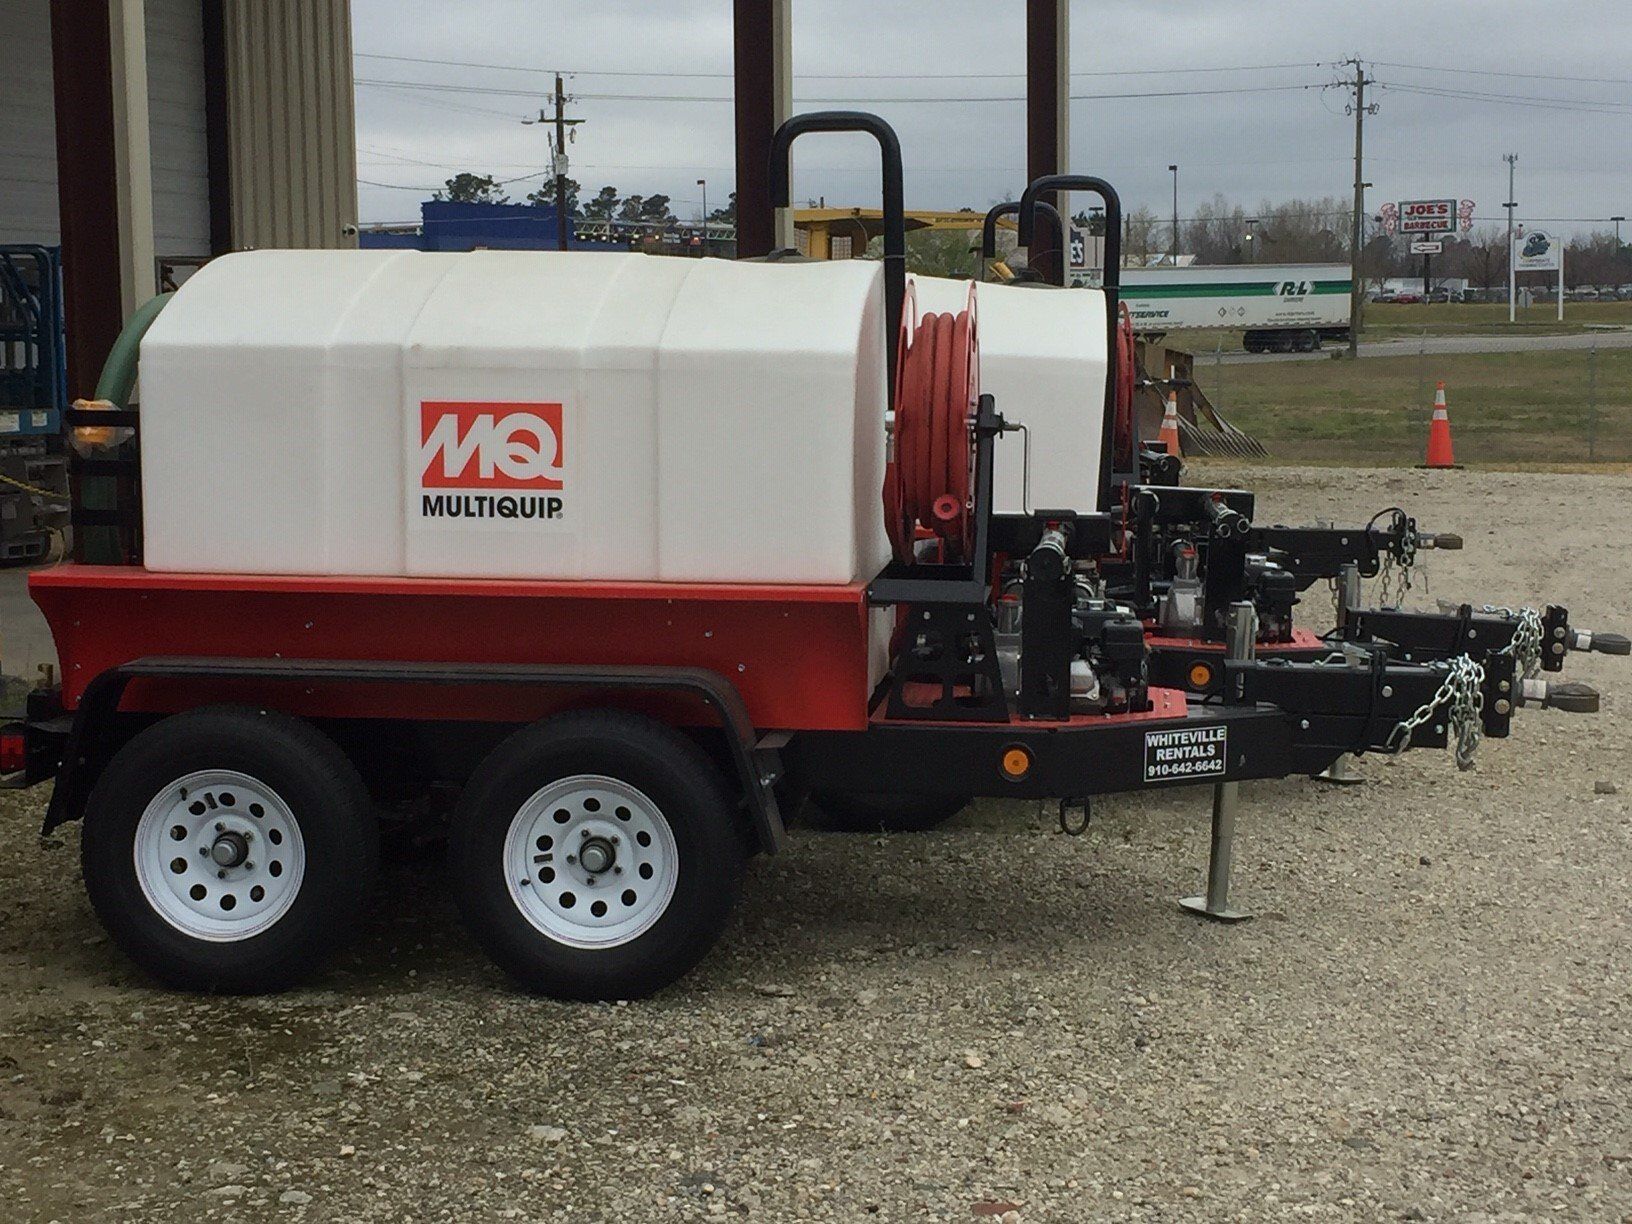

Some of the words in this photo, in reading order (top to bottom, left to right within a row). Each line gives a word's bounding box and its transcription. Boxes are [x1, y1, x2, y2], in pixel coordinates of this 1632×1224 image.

[1405, 204, 1448, 216] JOE'S
[1404, 220, 1448, 230] BARBECUE
[421, 411, 563, 481] MQ
[422, 494, 563, 519] MULTIQUIP
[1146, 729, 1225, 747] WHITEVILLE
[1156, 744, 1216, 761] RENTALS
[1147, 759, 1223, 776] 910-642-6642
